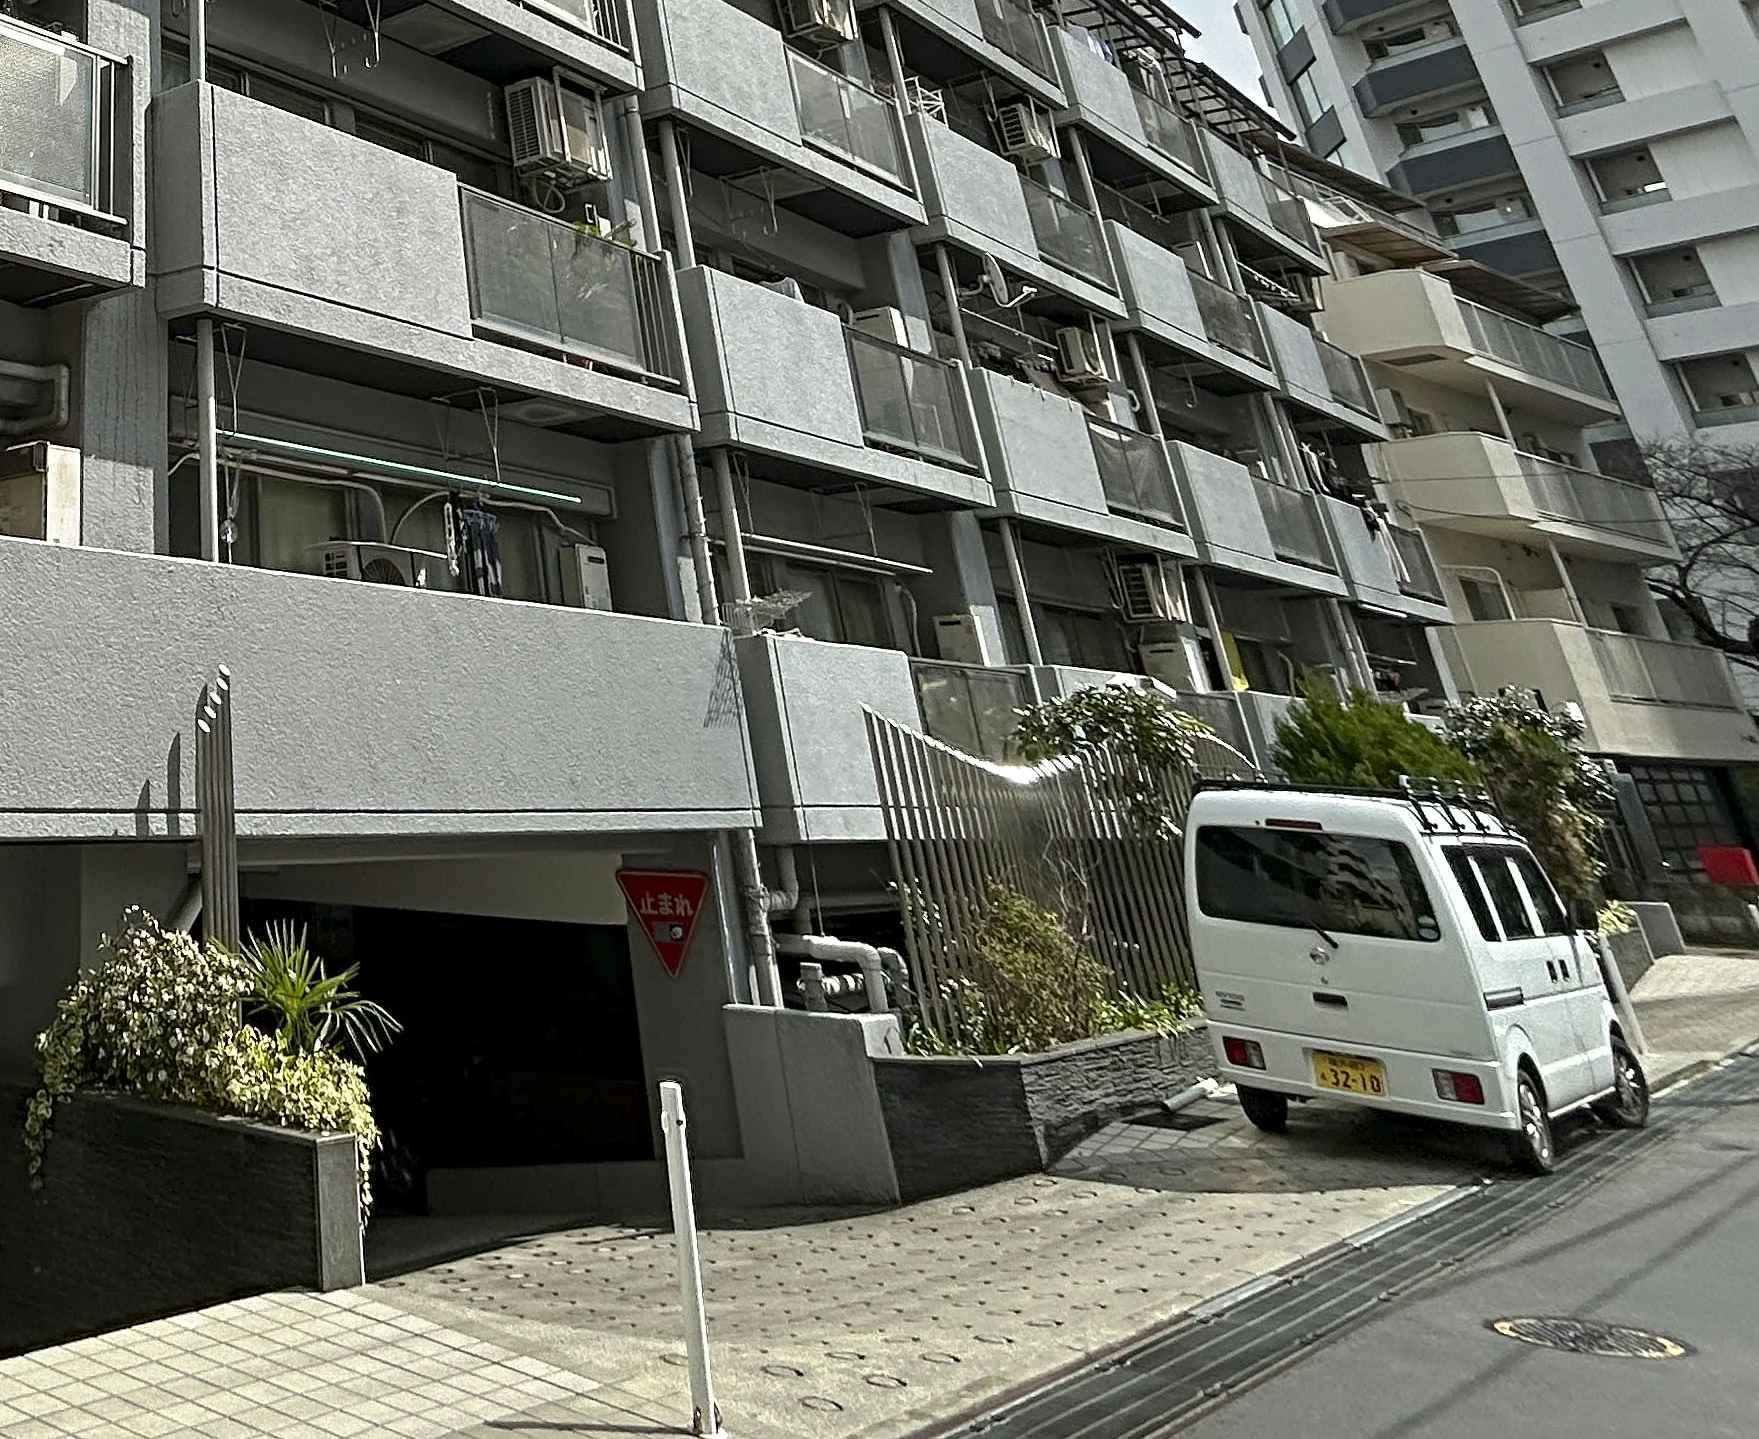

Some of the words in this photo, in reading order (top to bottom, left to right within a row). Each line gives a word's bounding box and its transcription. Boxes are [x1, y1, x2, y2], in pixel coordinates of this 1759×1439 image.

[640, 891, 694, 917] 止まれ
[1329, 1068, 1382, 1093] 32-10
